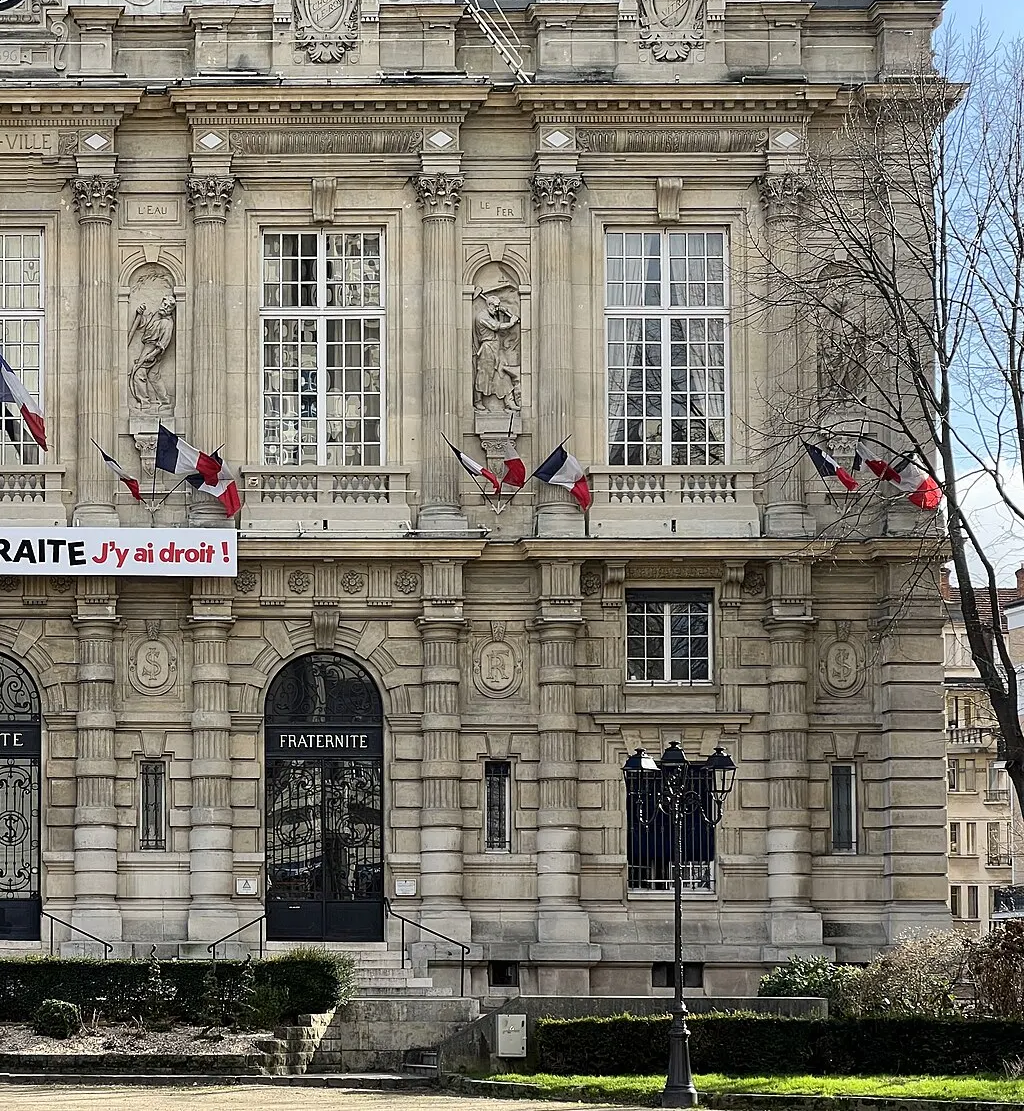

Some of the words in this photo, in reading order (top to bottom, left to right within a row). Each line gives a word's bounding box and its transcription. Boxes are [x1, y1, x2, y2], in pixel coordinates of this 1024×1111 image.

[138, 205, 167, 215] L'EAU
[480, 201, 490, 209] LE
[496, 207, 514, 216] FER
[159, 542, 216, 563] droit
[280, 735, 368, 748] FRATERNITE
